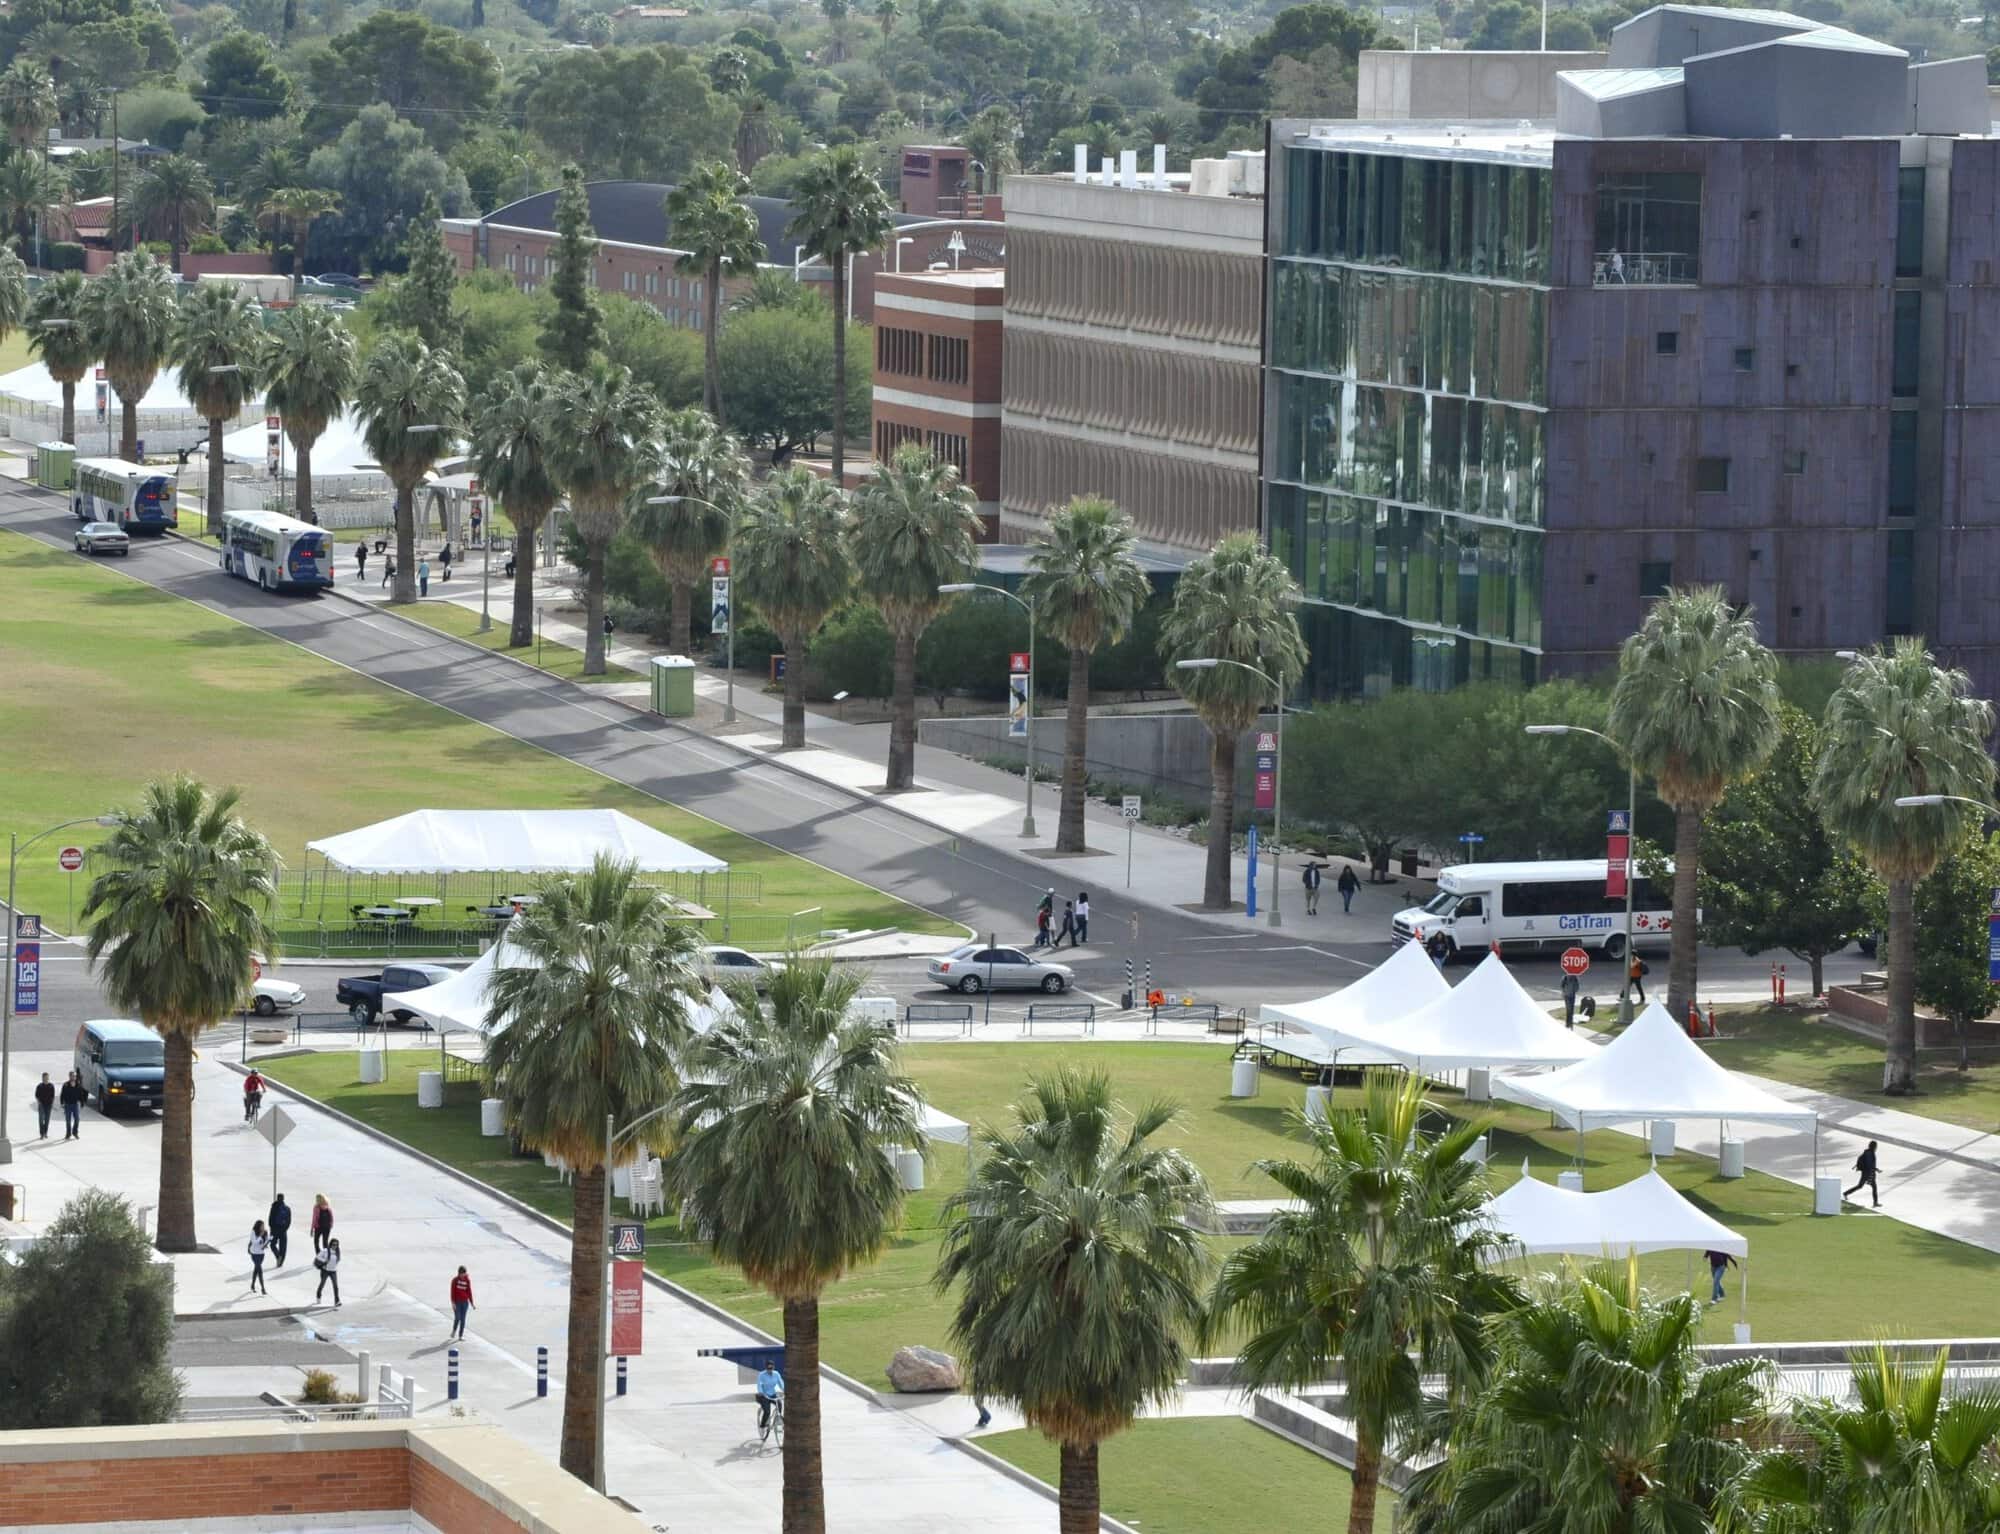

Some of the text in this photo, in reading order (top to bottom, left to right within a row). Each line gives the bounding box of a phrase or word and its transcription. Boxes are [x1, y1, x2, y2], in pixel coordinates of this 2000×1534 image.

[1125, 808, 1138, 817] 20
[18, 917, 39, 937] A
[1559, 914, 1613, 929] CatTran
[1563, 956, 1587, 967] STOP
[18, 962, 37, 982] 125
[615, 1226, 642, 1253] A
